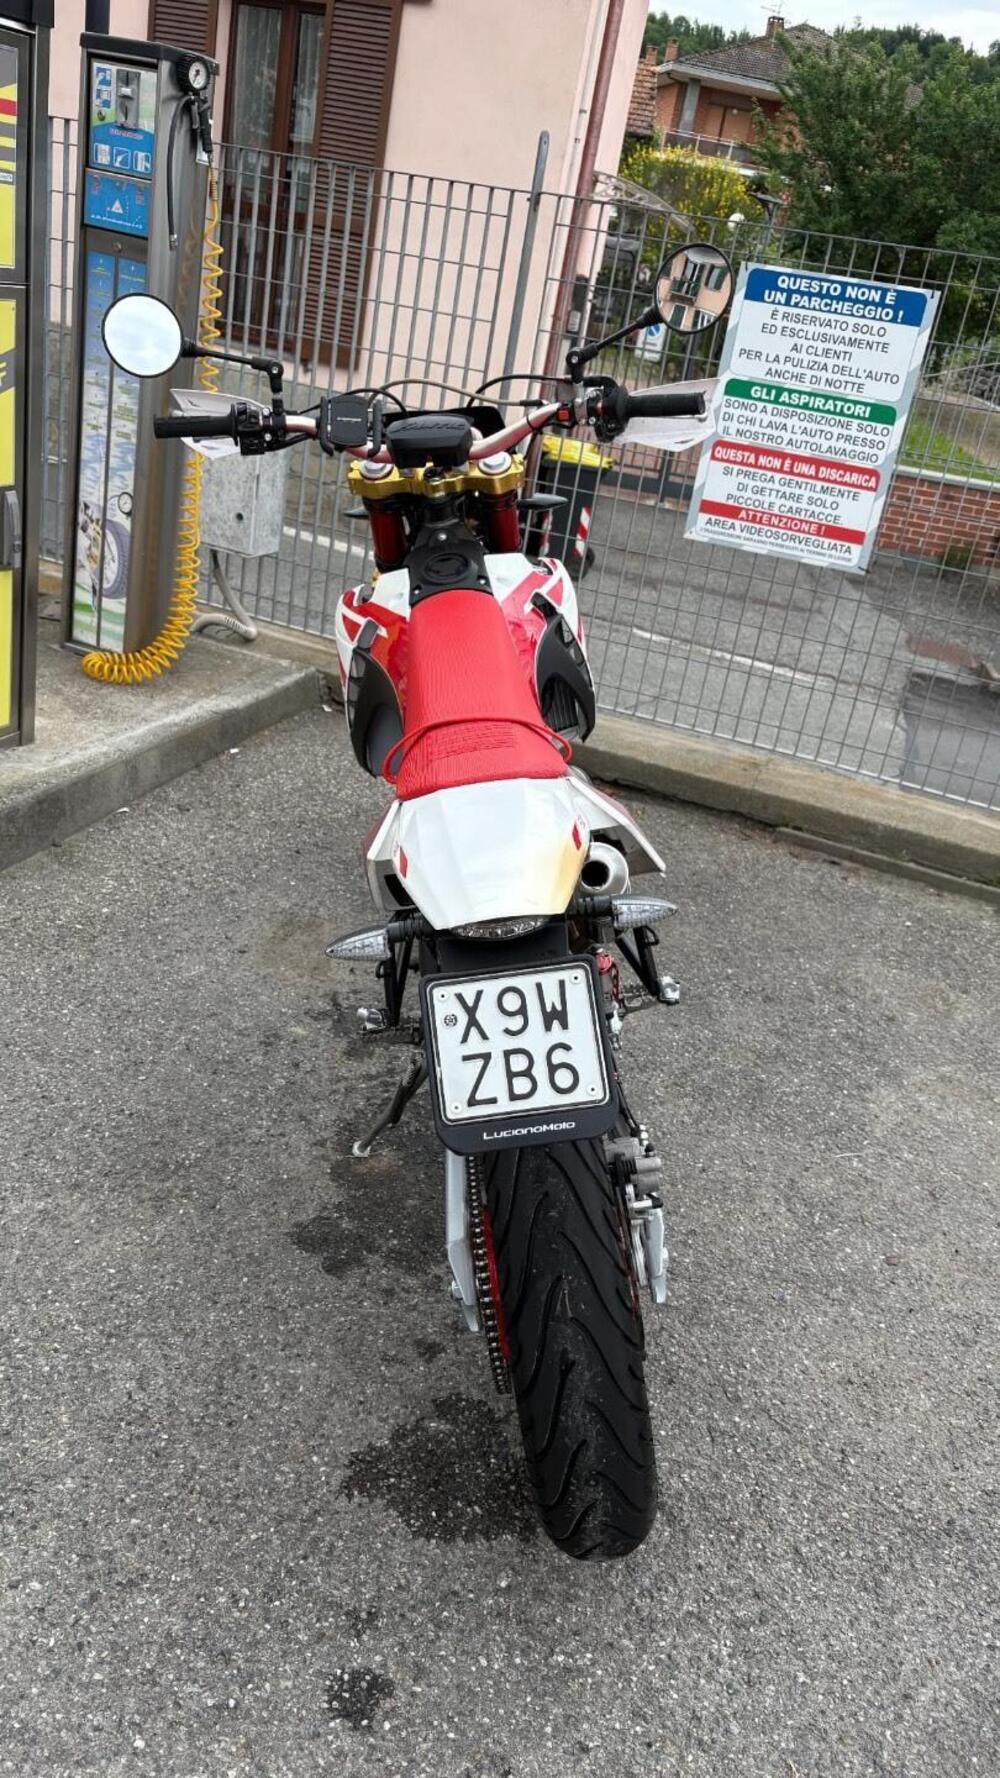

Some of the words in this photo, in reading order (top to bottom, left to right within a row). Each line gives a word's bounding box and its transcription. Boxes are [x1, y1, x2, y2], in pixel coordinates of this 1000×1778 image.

[764, 290, 787, 304] UN
[790, 294, 894, 321] PARCHEGGIO
[898, 310, 904, 323] !
[778, 276, 841, 296] QUESTO
[845, 287, 882, 303] NON
[885, 289, 897, 305] È
[761, 323, 777, 335] ED
[780, 327, 890, 353] ESCLUSIVAMENTE
[771, 307, 779, 321] È
[781, 312, 849, 331] RISERVATO
[852, 322, 887, 337] SOLO
[738, 348, 762, 361] PER
[765, 352, 781, 365] LA
[783, 356, 829, 373] PULIZIA
[831, 364, 900, 385] DELL'AUTO
[790, 343, 803, 354] AI
[805, 345, 853, 362] CLIENTI
[764, 368, 806, 383] ANCHE
[809, 375, 822, 386] DI
[824, 377, 866, 394] NOTTE
[724, 399, 758, 413] SONO
[758, 405, 769, 415] A
[770, 407, 852, 431] DISPOSIZIONE
[855, 423, 890, 437] SOLO
[750, 386, 775, 401] GLI
[778, 391, 872, 418] ASPIRATORI
[722, 412, 735, 422] DI
[737, 414, 757, 425] CHI
[759, 418, 788, 433] LAVA
[791, 424, 833, 441] L'AUTO
[836, 432, 886, 451] PRESSO
[722, 426, 731, 436] IL
[735, 428, 784, 446] NOSTRO
[786, 437, 879, 464] AUTOLAVAGGIO
[714, 446, 755, 465] QUESTA
[757, 455, 782, 469] NON
[783, 457, 792, 471] È
[793, 461, 816, 476] UNA
[818, 467, 877, 488] DISCARICA
[722, 466, 733, 477] SI
[736, 468, 775, 484] PREGA
[778, 476, 861, 501] GENTILMENTE
[737, 482, 748, 493] DI
[751, 485, 805, 504] GETTARE
[807, 496, 839, 511] SOLO
[726, 493, 775, 513] PICCOLE
[778, 503, 844, 525] CARTACCE.
[738, 509, 818, 534] ATTENZIONE
[820, 526, 826, 535] !
[705, 517, 736, 533] AREA
[739, 523, 852, 556] VIDEOSORVEGLIATA
[454, 979, 569, 1044] X9W
[461, 1042, 580, 1108] ZB6
[483, 1121, 576, 1140] LucianoMoto
